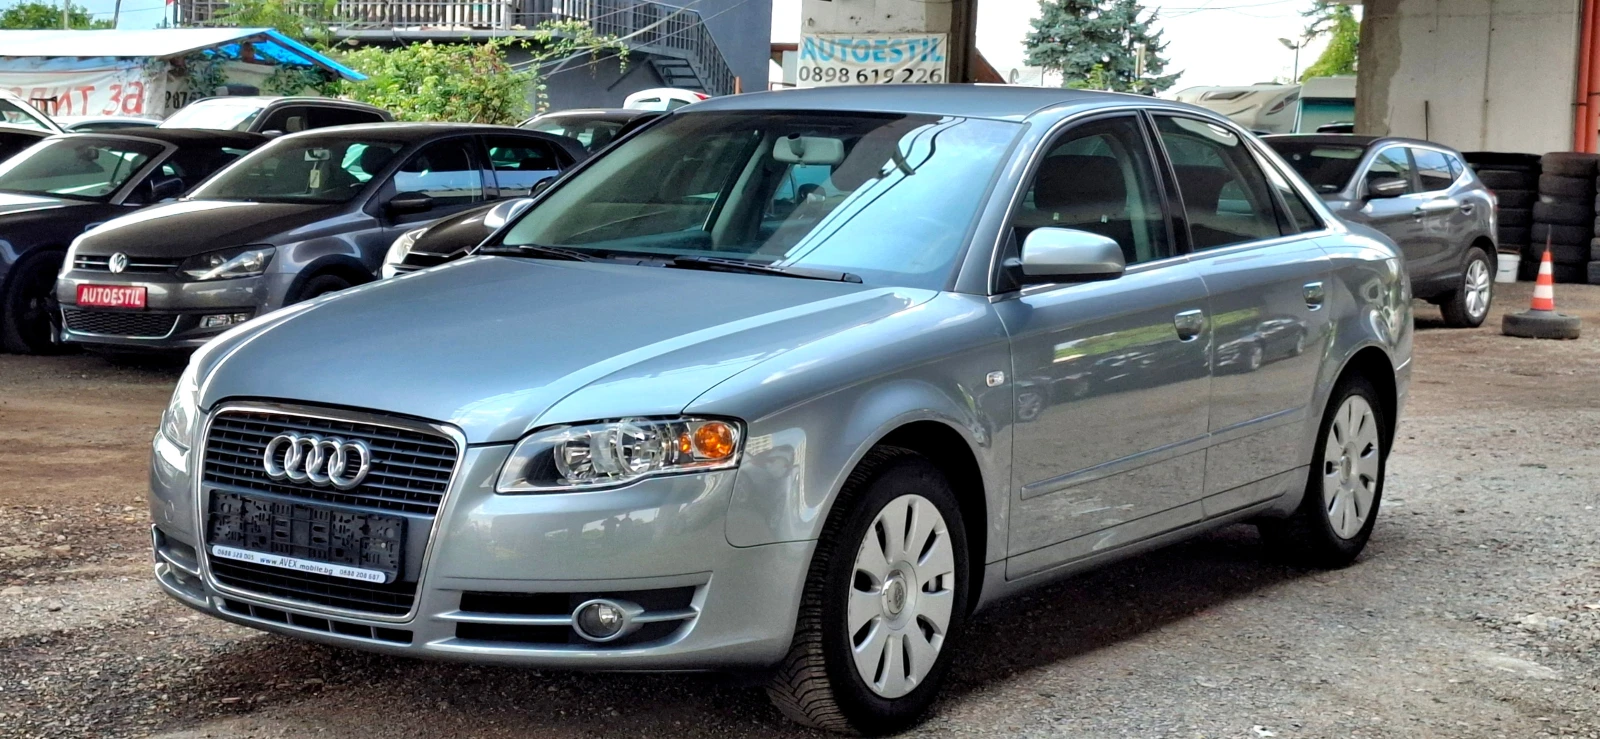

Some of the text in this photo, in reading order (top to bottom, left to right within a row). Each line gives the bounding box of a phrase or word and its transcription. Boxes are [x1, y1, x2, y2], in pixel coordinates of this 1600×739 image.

[800, 36, 944, 63] AUTOESTIL
[799, 66, 942, 84] 0898 619 226
[80, 287, 141, 305] AUTOESTIL
